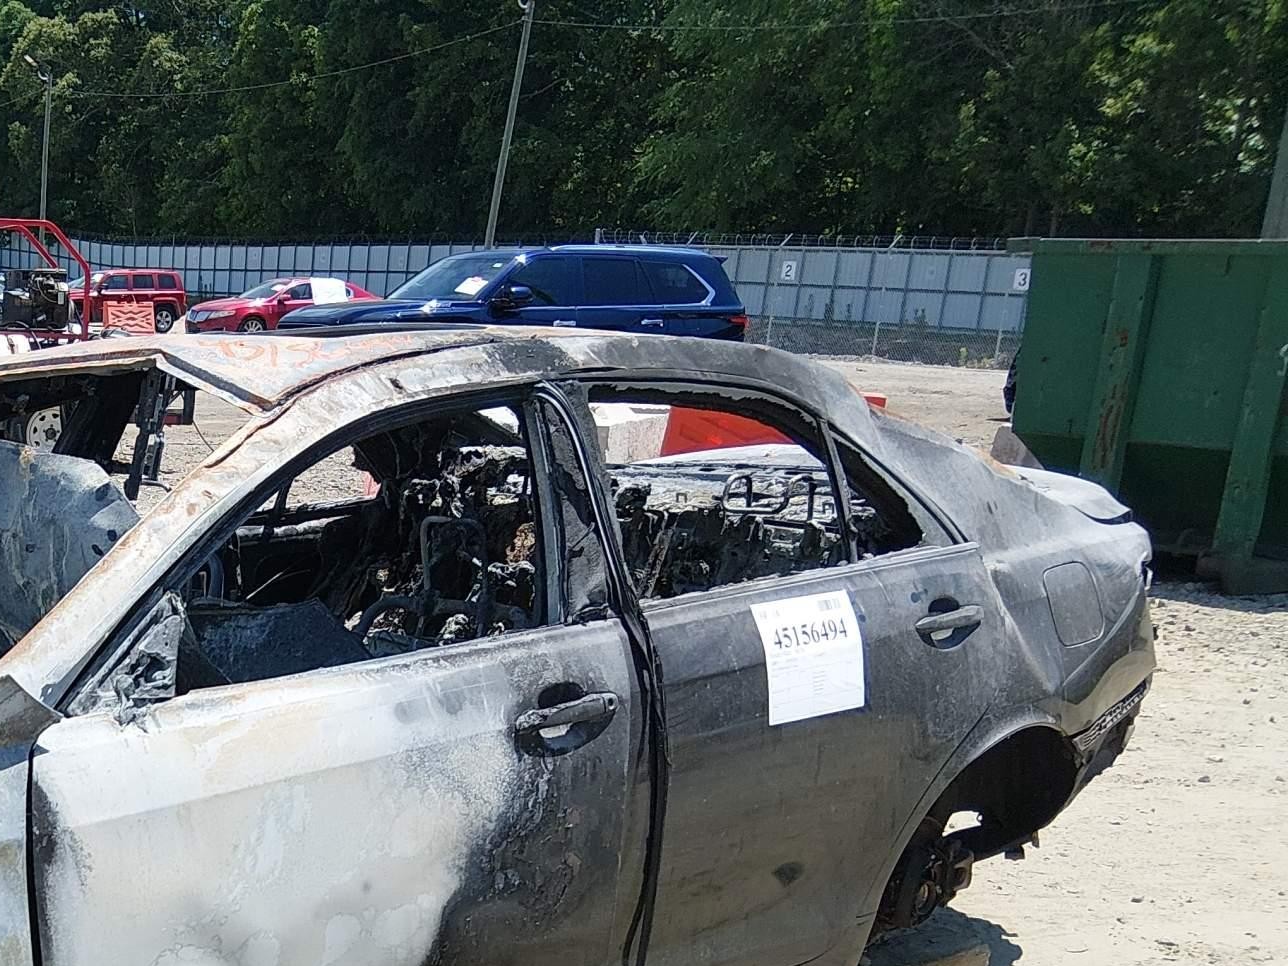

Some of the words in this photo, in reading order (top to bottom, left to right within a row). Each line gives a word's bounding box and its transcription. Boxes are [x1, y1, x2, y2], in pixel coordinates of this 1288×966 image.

[784, 264, 793, 278] 2
[1017, 272, 1028, 287] 3
[774, 617, 848, 649] 45156494
